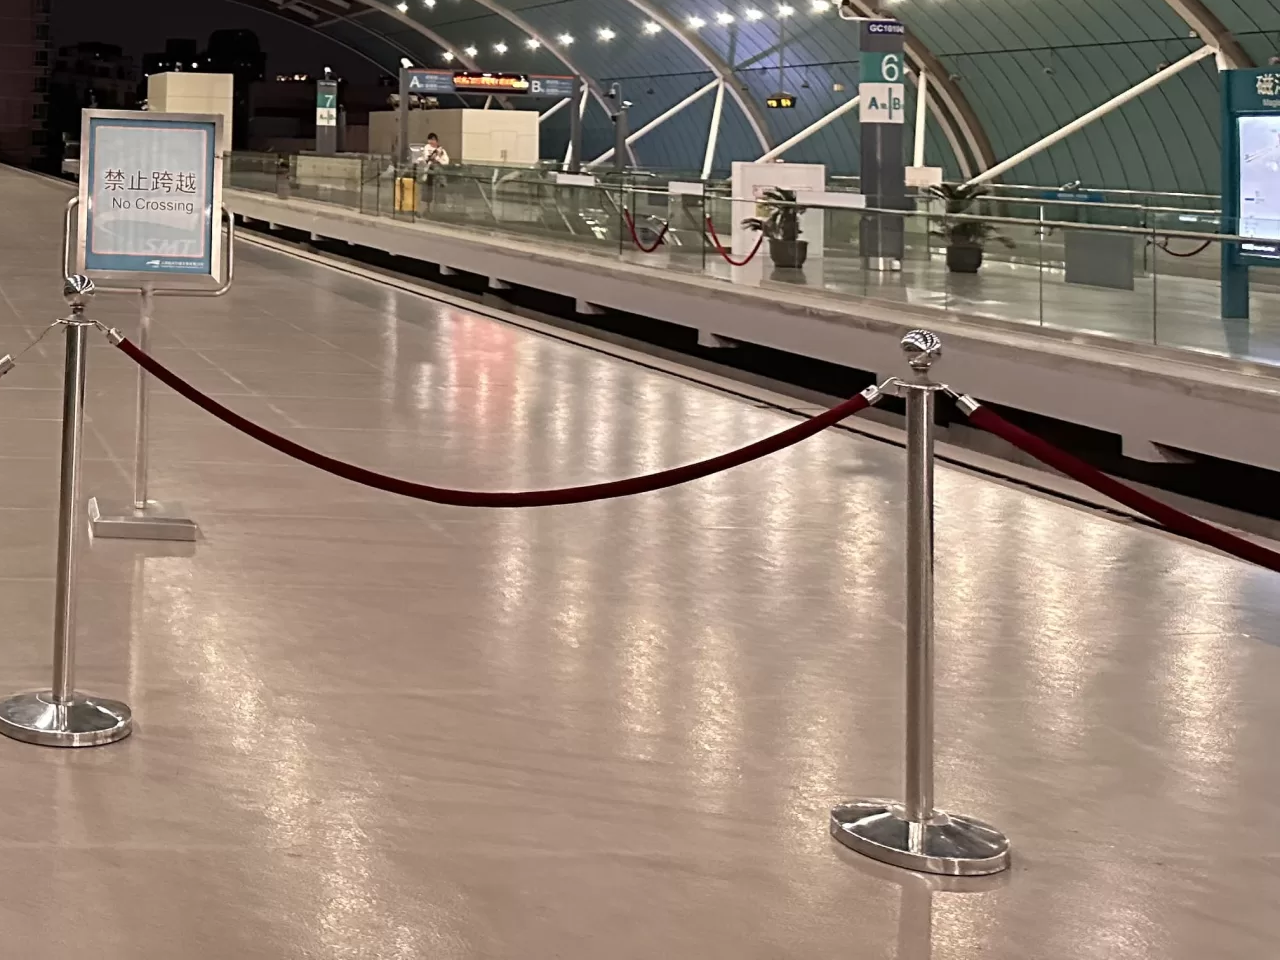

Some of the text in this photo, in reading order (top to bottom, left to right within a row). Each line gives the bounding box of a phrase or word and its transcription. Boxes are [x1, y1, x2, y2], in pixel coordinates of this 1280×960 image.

[881, 54, 899, 81] 6
[409, 76, 420, 88] A
[531, 80, 541, 93] B
[324, 94, 333, 108] 7
[104, 169, 196, 194] 禁止跨越
[112, 197, 194, 214] No Crossing
